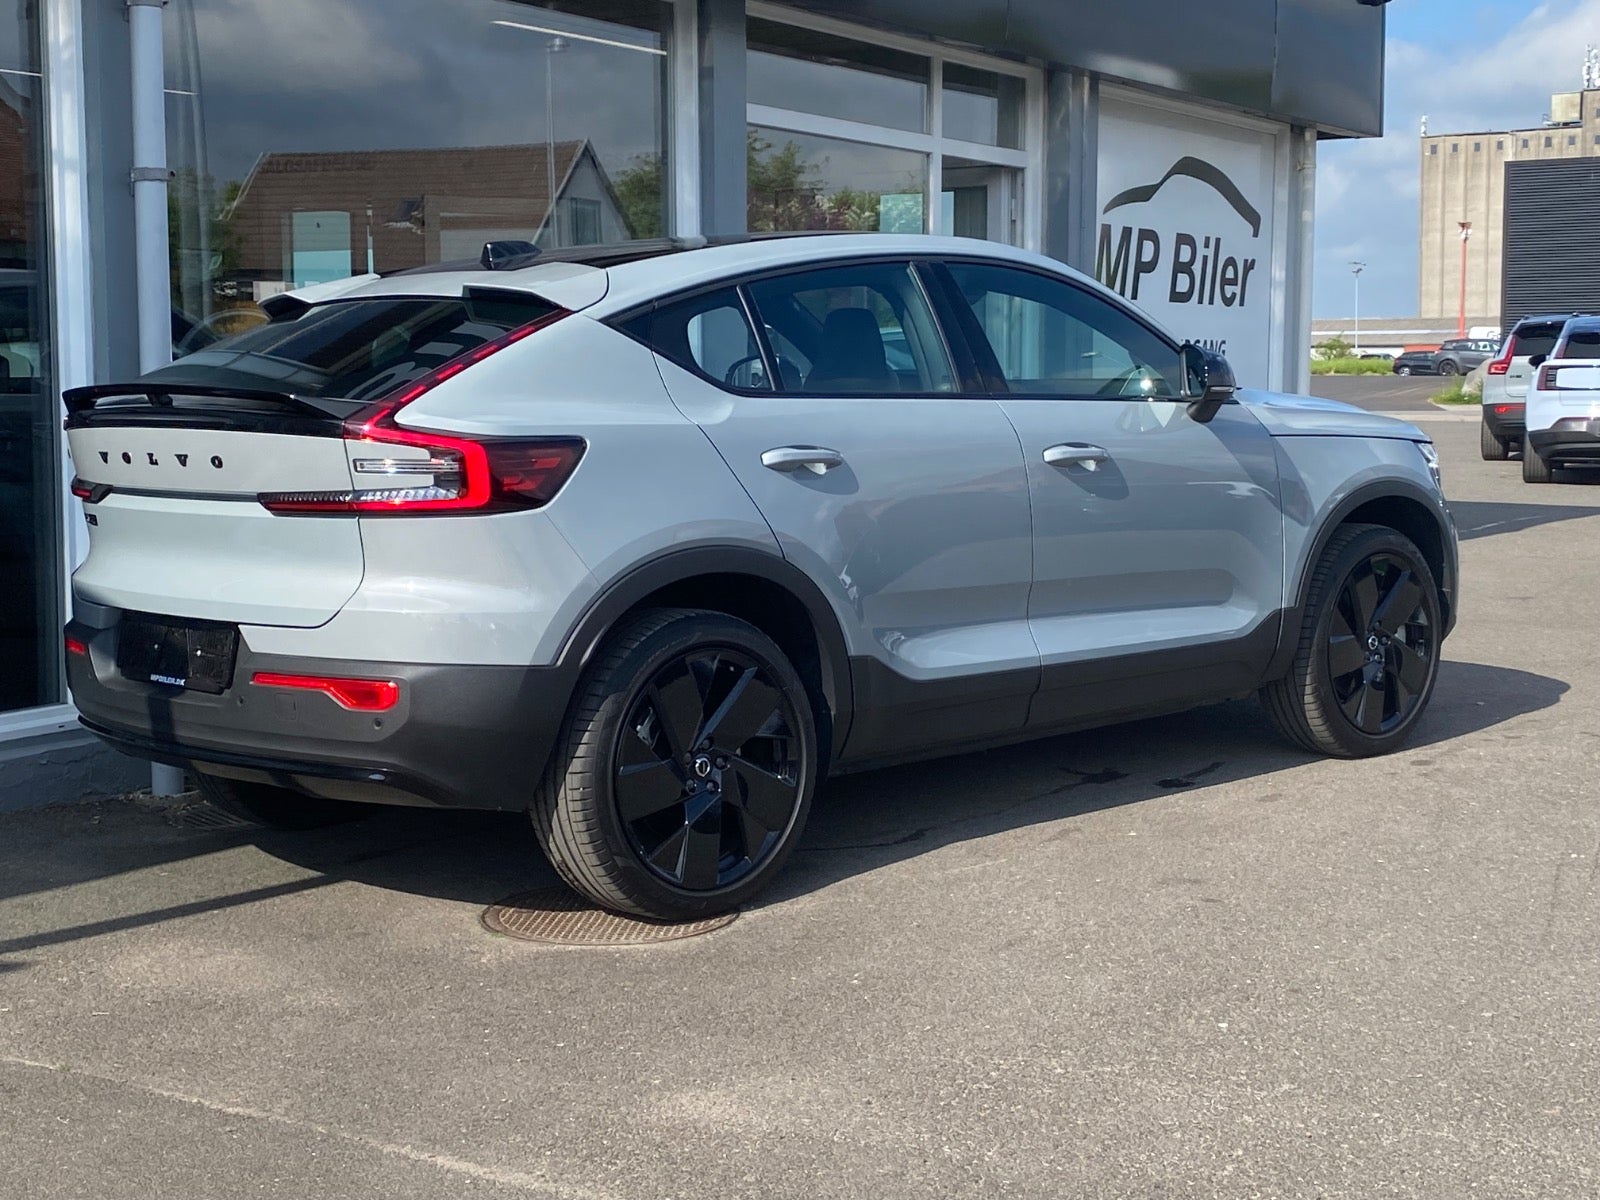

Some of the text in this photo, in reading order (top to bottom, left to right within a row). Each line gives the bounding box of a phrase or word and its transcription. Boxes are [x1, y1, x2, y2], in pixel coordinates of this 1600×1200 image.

[1095, 223, 1256, 307] MP Biler
[98, 451, 224, 469] VOLVO
